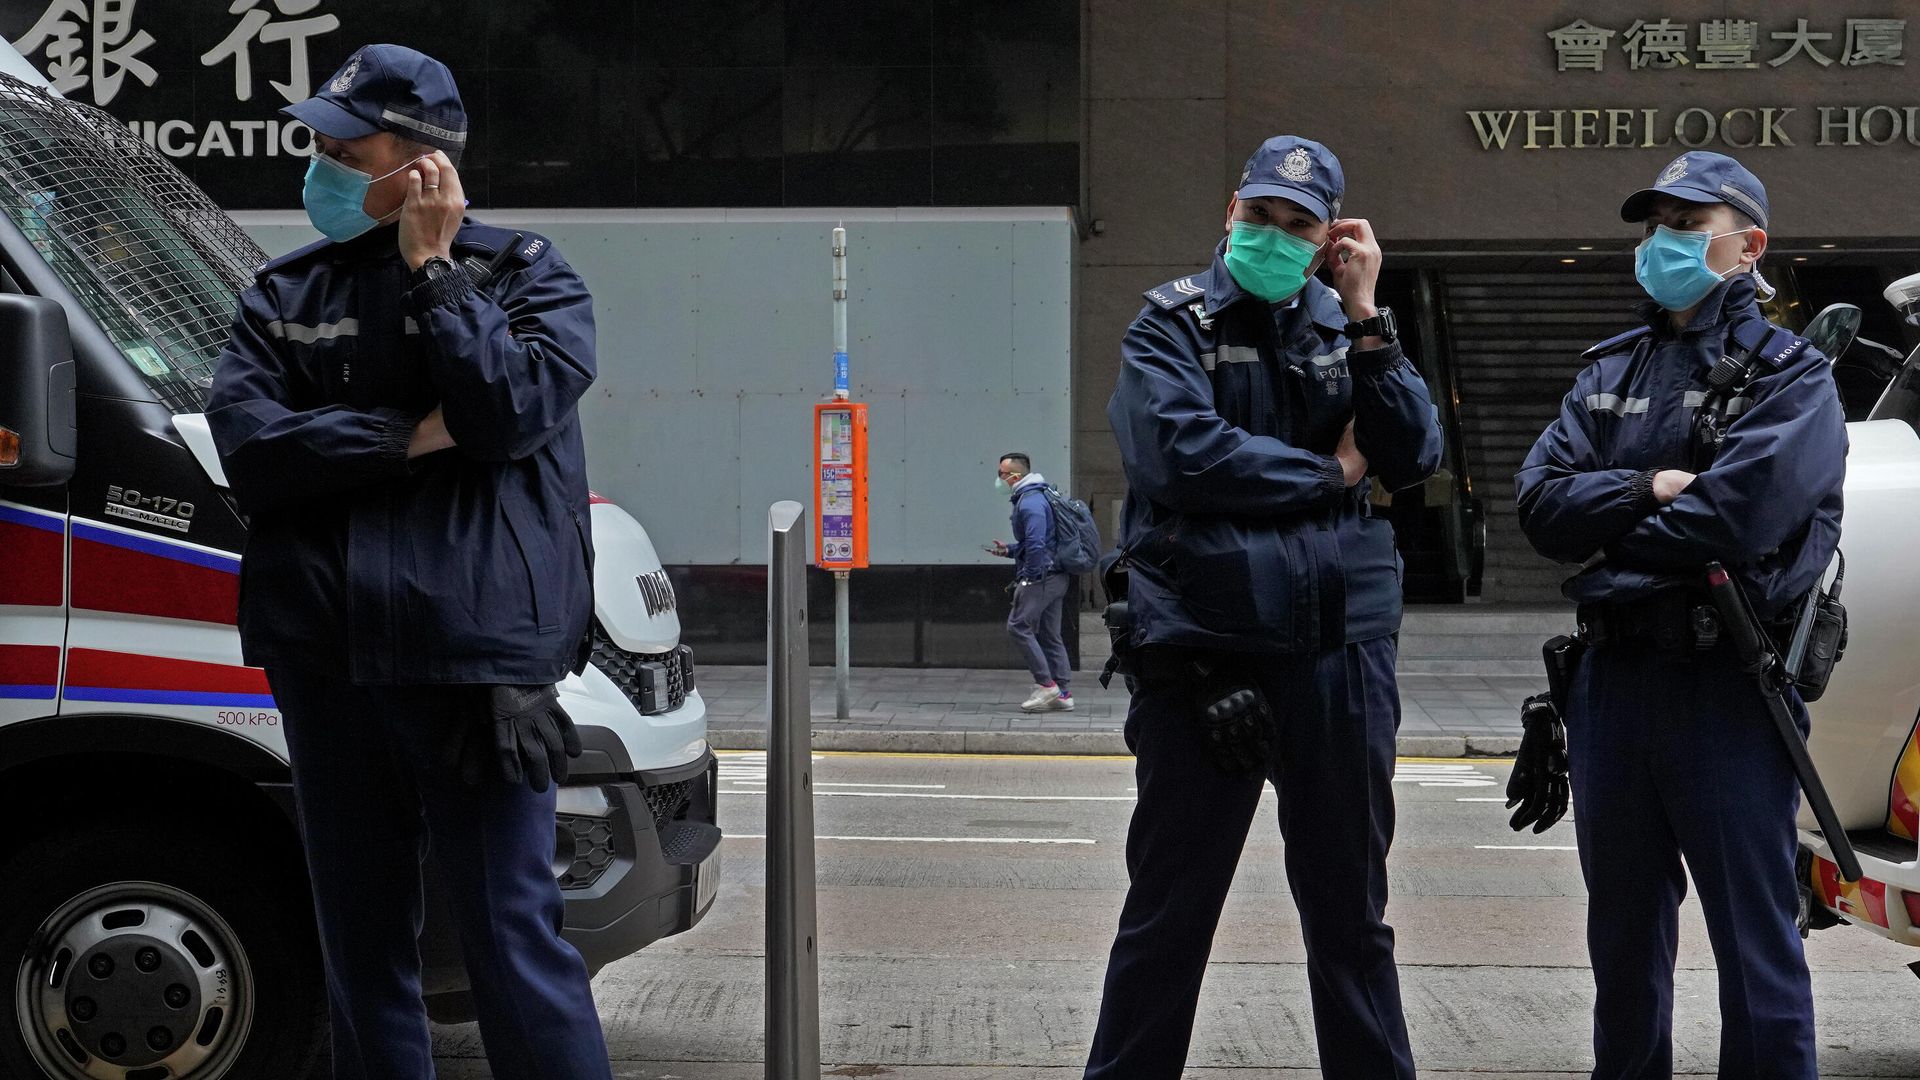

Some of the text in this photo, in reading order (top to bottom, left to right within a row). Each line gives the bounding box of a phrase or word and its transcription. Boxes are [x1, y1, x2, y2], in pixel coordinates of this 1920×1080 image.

[11, 0, 341, 105] 銀行
[425, 125, 449, 139] POLICE
[1466, 107, 1797, 150] WHEELOCK
[524, 239, 544, 257] 7695
[1150, 290, 1174, 305] 58747
[1773, 340, 1802, 363] 18016
[1319, 366, 1350, 379] POLI
[1326, 381, 1339, 396] 警
[823, 468, 835, 479] 15C
[106, 485, 194, 518] 50-170
[216, 711, 278, 726] 500 kPa
